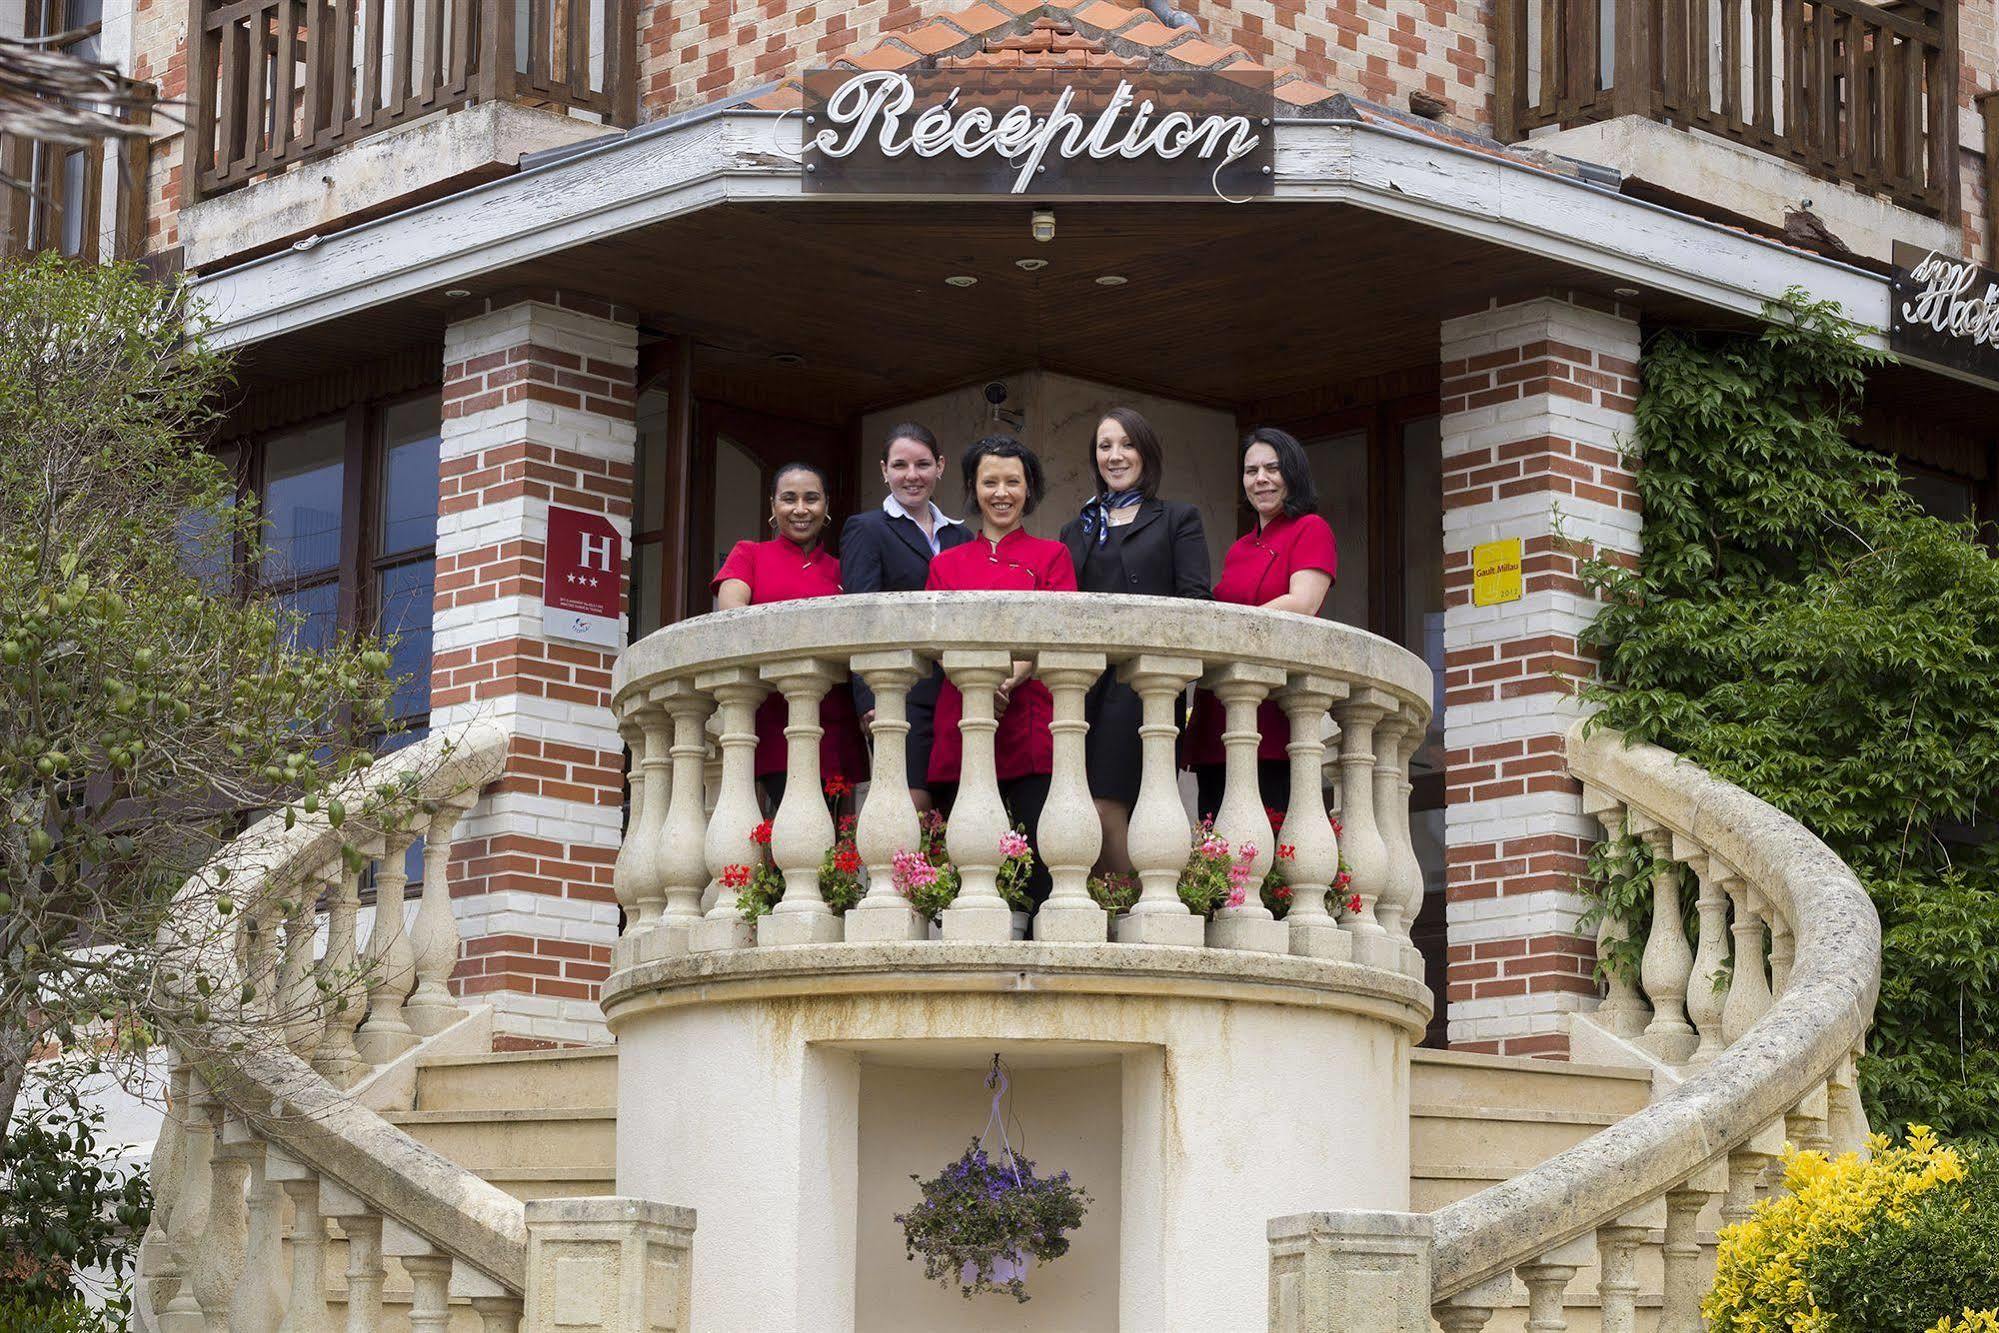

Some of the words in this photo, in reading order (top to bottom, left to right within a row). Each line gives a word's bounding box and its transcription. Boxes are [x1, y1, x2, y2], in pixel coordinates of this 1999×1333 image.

[816, 70, 1260, 194] Réception
[578, 531, 615, 573] H
[1476, 566, 1495, 577] Gault
[1497, 563, 1519, 573] Millau
